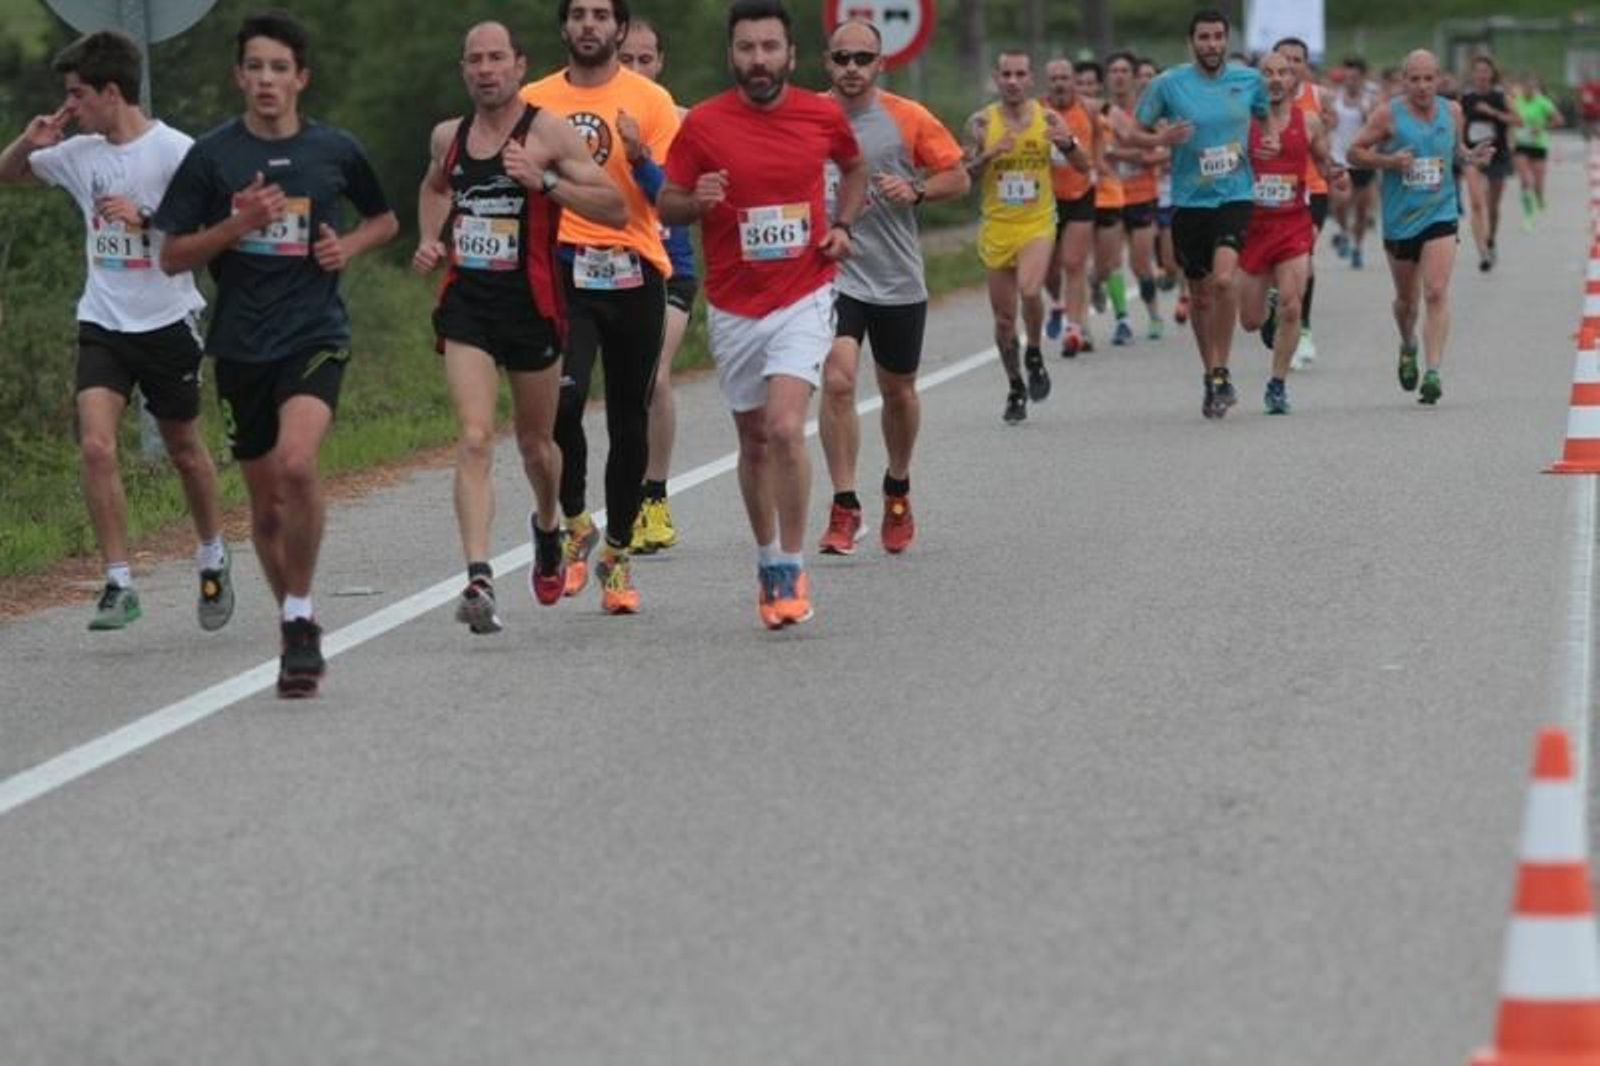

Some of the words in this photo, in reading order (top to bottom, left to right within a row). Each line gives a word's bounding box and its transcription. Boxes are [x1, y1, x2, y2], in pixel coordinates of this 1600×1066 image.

[746, 223, 795, 246] 366
[95, 235, 133, 257] 681
[458, 235, 501, 257] 669
